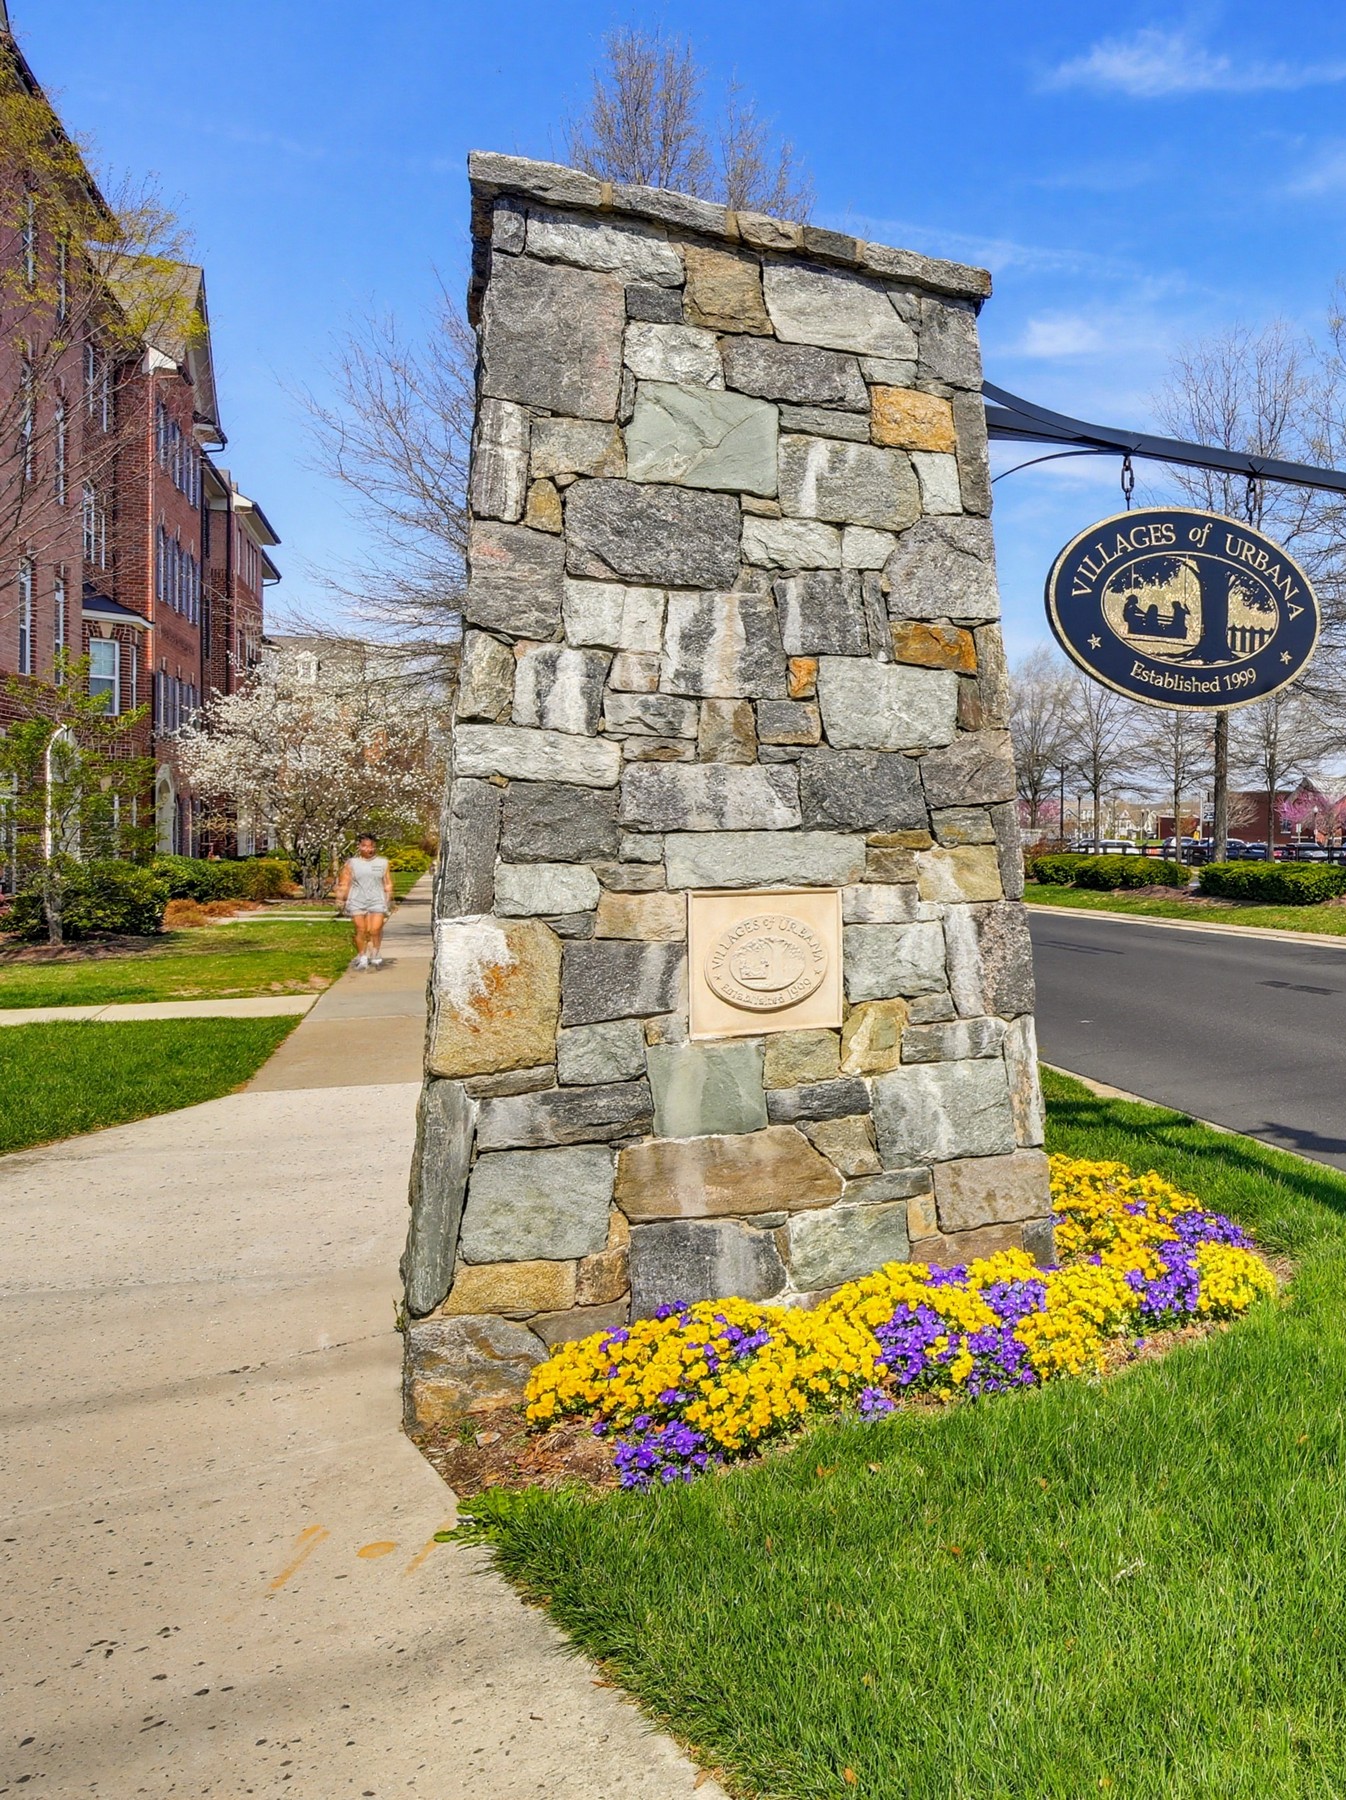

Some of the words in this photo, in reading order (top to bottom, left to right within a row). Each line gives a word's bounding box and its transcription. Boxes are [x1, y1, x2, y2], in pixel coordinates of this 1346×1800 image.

[1071, 523, 1177, 597] VILLAGES
[1188, 523, 1213, 548] of
[1225, 533, 1305, 622] URBANA
[1130, 660, 1221, 693] Established
[1223, 667, 1257, 691] 1999
[711, 919, 760, 970] VILLAGES
[762, 917, 775, 931] of
